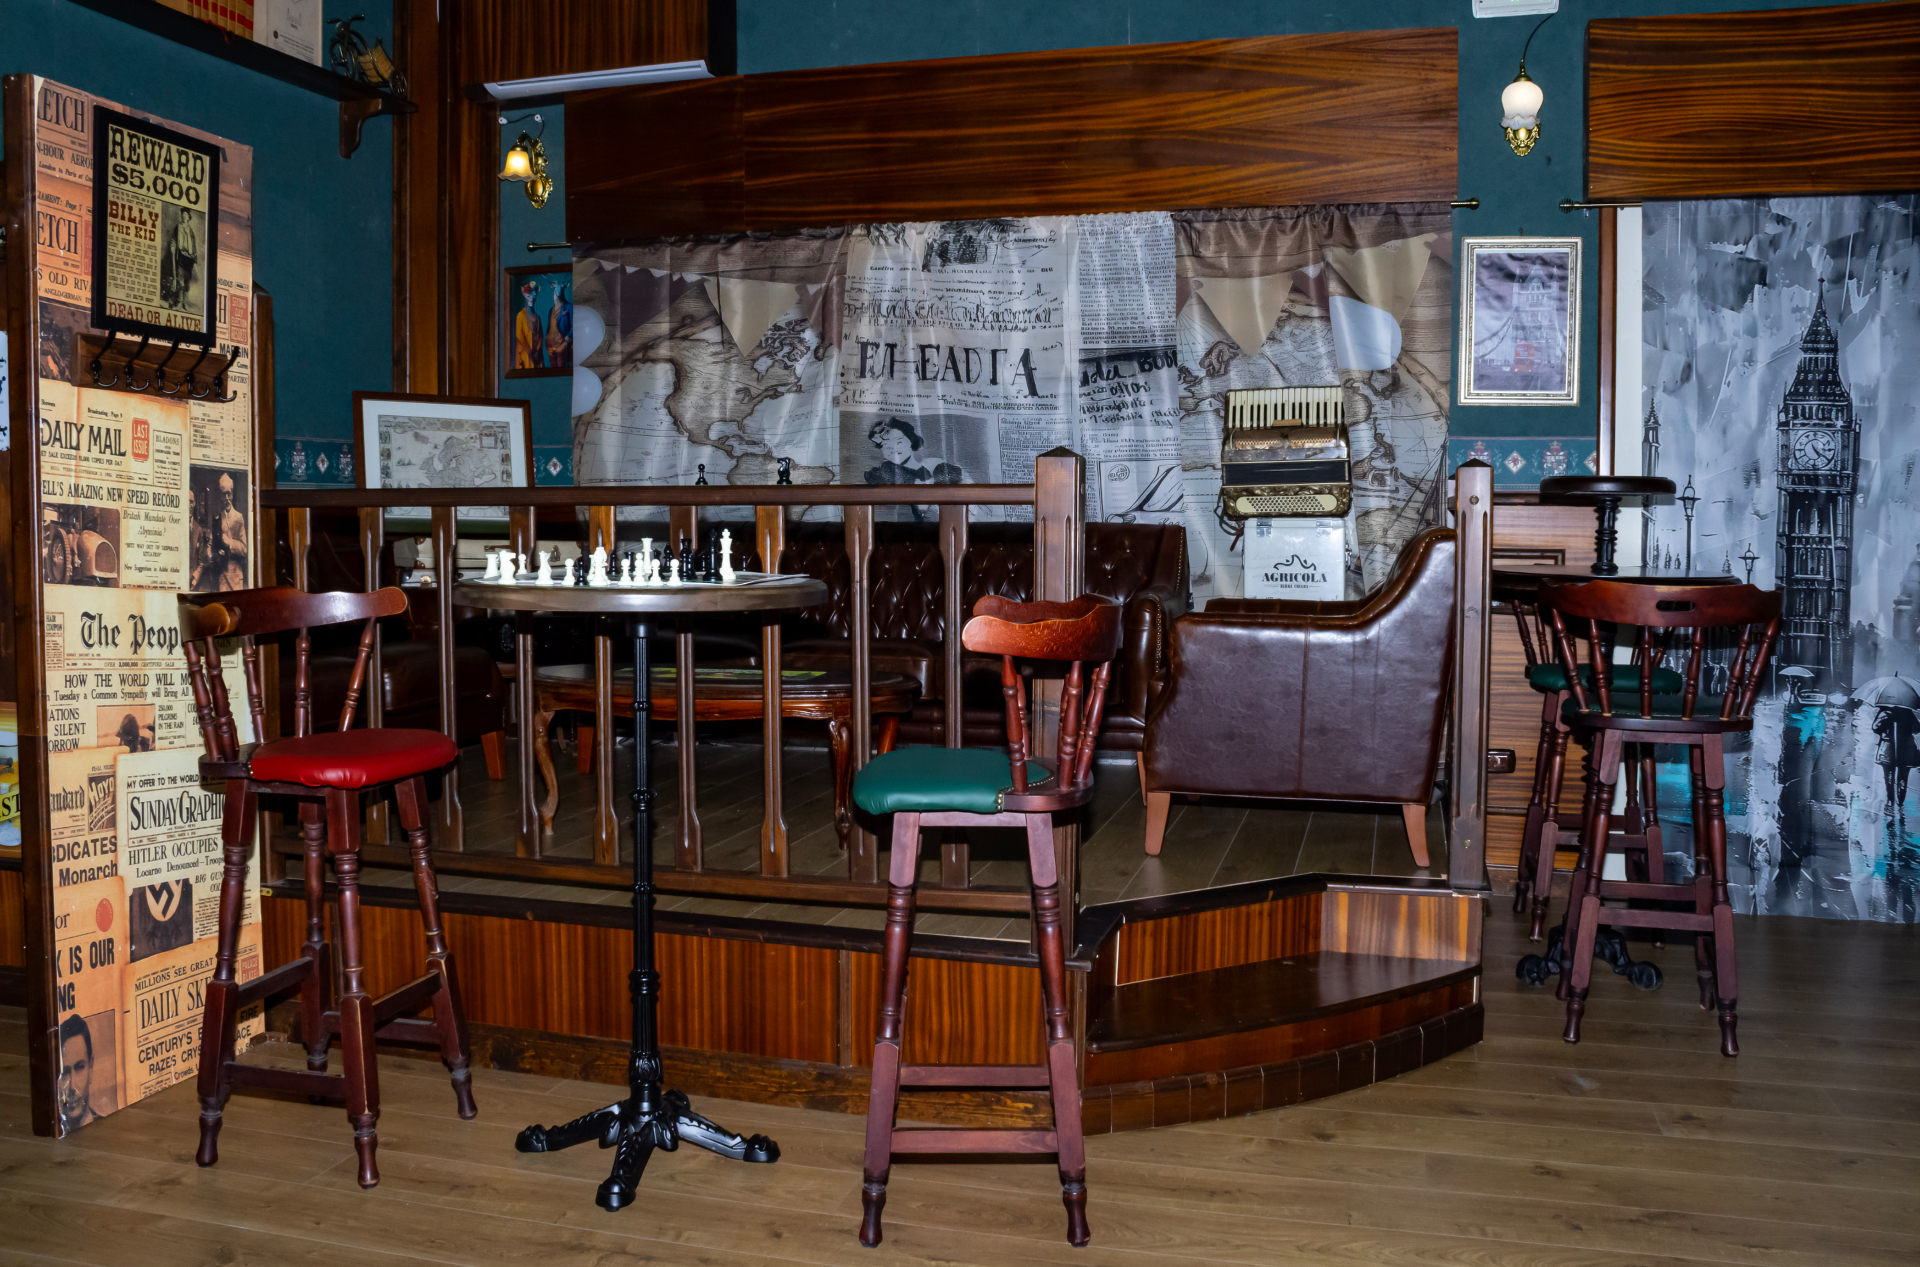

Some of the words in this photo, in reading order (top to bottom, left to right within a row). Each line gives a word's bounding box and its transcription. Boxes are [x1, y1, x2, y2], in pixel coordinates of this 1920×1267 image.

[37, 87, 85, 133] ETCH
[109, 126, 205, 185] REWARD
[111, 162, 200, 206] $5,000
[109, 199, 160, 230] BILLY
[109, 221, 131, 236] THE
[134, 225, 156, 242] KID
[48, 270, 68, 287] OLD
[108, 301, 144, 322] DEAD
[146, 309, 161, 326] OR
[165, 312, 201, 331] ALIVE
[41, 417, 85, 451] DAILY
[87, 425, 127, 458] MAIL
[133, 422, 149, 439] LAST
[48, 451, 59, 459] SALE
[133, 440, 148, 455] ISSUE
[41, 480, 64, 497] ELL'S
[67, 483, 104, 501] AMAZING
[106, 486, 124, 503] NEW
[127, 488, 149, 505] SPEED
[152, 491, 180, 508] RECORD
[123, 509, 141, 521] British
[144, 511, 167, 523] Mandate
[169, 514, 181, 525] Over
[1262, 572, 1328, 583] AGRICOLA
[80, 610, 122, 650] The
[64, 674, 88, 689] HOW
[94, 673, 113, 688] THE
[118, 673, 149, 687] WORLD
[155, 672, 175, 686] WILL
[54, 690, 80, 703] Tuesday
[91, 689, 118, 700] Common
[120, 687, 148, 701] Sympathy
[151, 687, 161, 698] will
[48, 707, 80, 722] ATIONS
[164, 722, 173, 730] THE
[174, 720, 184, 729] RAIN
[54, 722, 87, 737] SILENT
[127, 780, 137, 790] MY
[139, 777, 155, 788] OFFER
[158, 777, 165, 786] TO
[167, 775, 178, 785] THE
[130, 795, 179, 831] SUNDAY
[128, 844, 168, 866] HITLER
[171, 836, 219, 858] OCCUPIES
[58, 859, 118, 888] Monarch
[136, 867, 163, 879] Locarno
[69, 944, 83, 975] IS
[89, 937, 115, 970] OUR
[134, 971, 171, 993] MILLIONS
[173, 965, 187, 978] SEE
[190, 957, 213, 973] GREAT
[139, 985, 182, 1031] DAILY
[240, 1004, 259, 1021] FIRE
[138, 1030, 193, 1065] CENTURY'S
[148, 1054, 177, 1077] RAZES
[173, 1066, 194, 1081] Crowds
